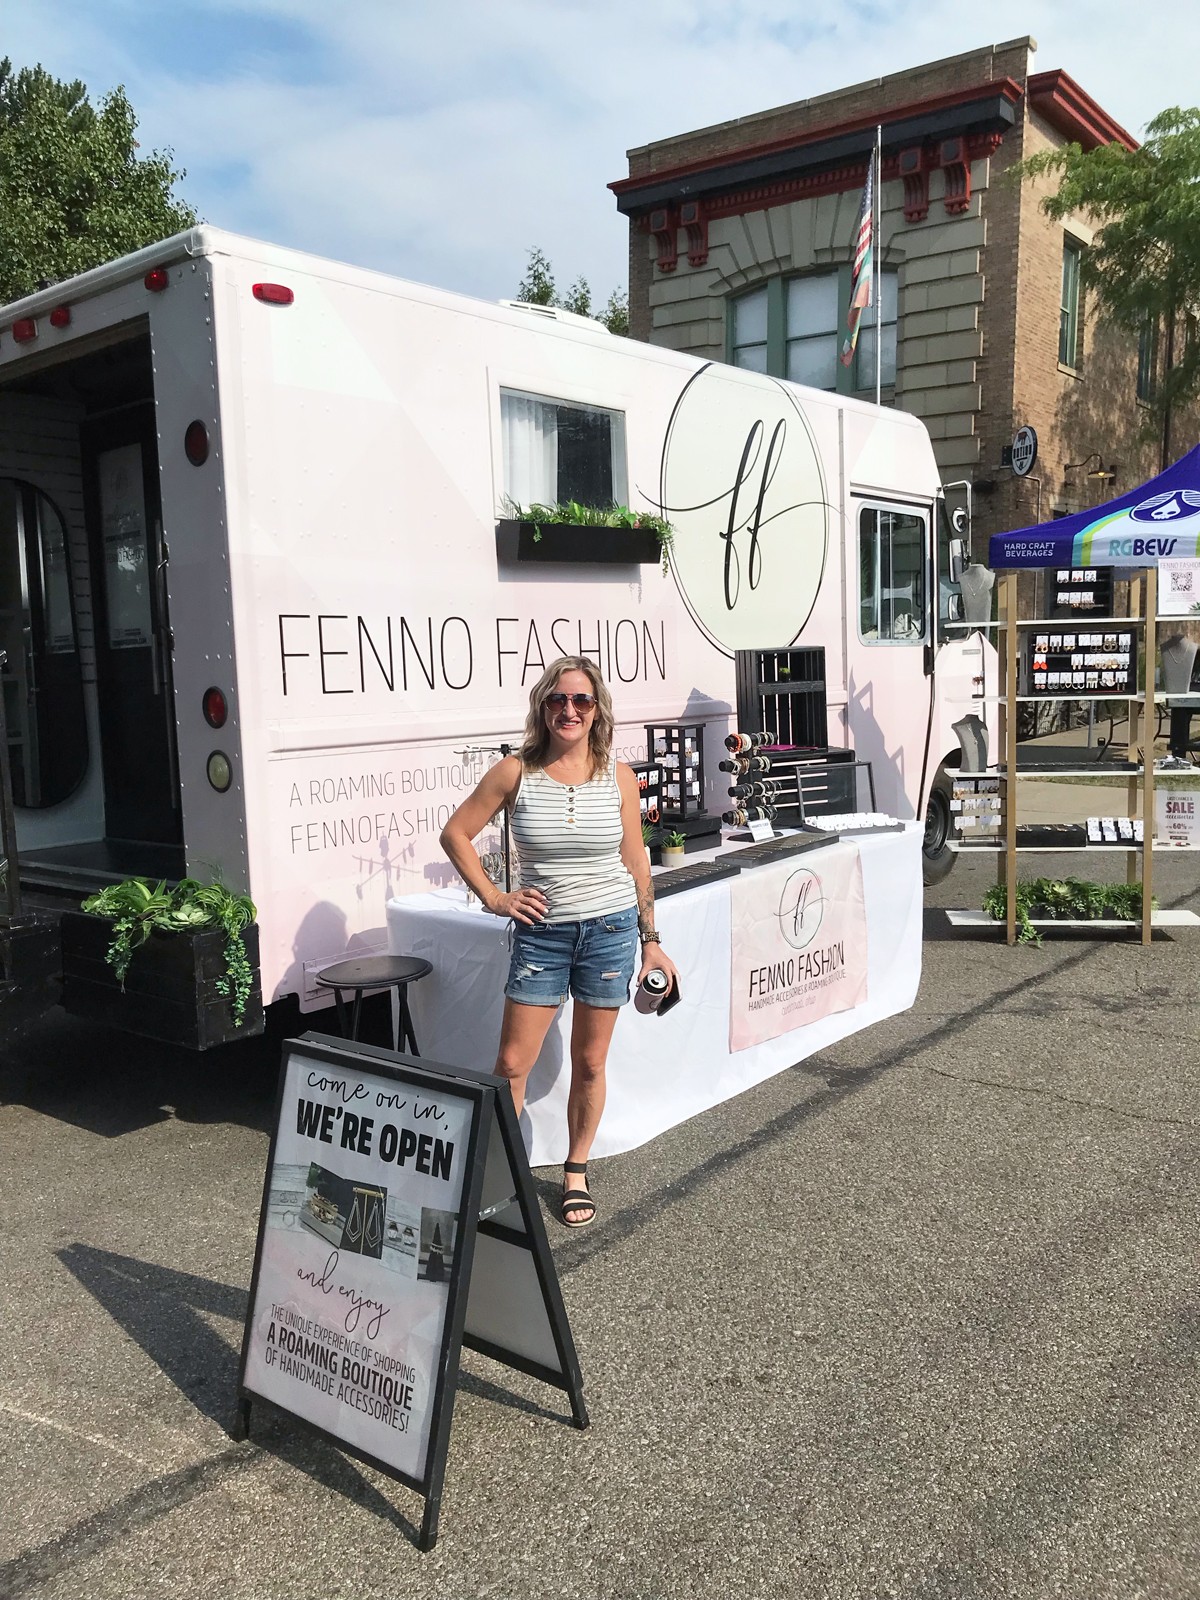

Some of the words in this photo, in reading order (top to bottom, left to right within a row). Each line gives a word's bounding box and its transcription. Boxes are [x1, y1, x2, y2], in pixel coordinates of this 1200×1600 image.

[1004, 543, 1026, 551] HARD
[1028, 542, 1056, 550] CRAFT
[1005, 550, 1054, 558] BEVERAGES
[1108, 539, 1178, 556] RGBEVS
[279, 615, 473, 696] FENNO
[496, 618, 666, 687] FASHION
[289, 782, 303, 807] A
[309, 771, 395, 806] ROAMING
[401, 762, 483, 794] BOUTIQUE
[1166, 802, 1194, 814] SALE
[749, 958, 795, 998] FENNO
[798, 940, 845, 982] FASHION
[307, 1071, 370, 1103] come
[376, 1092, 406, 1109] on
[296, 1098, 375, 1156] WE'RE
[379, 1123, 455, 1181] OPEN
[297, 1251, 339, 1294] and
[339, 1285, 391, 1340] enjoy
[266, 1321, 276, 1345] A
[279, 1327, 338, 1375] ROAMING
[341, 1356, 414, 1411] BOUTIQUE
[271, 1303, 285, 1323] THE
[285, 1310, 313, 1336] UNIQUE
[314, 1323, 361, 1359] EXPERIENCE
[361, 1346, 373, 1363] OF
[373, 1352, 416, 1384] SHOPPING
[265, 1346, 278, 1366] OF
[279, 1354, 335, 1397] HANDMADE
[336, 1383, 410, 1434] ACCESSORIES!
